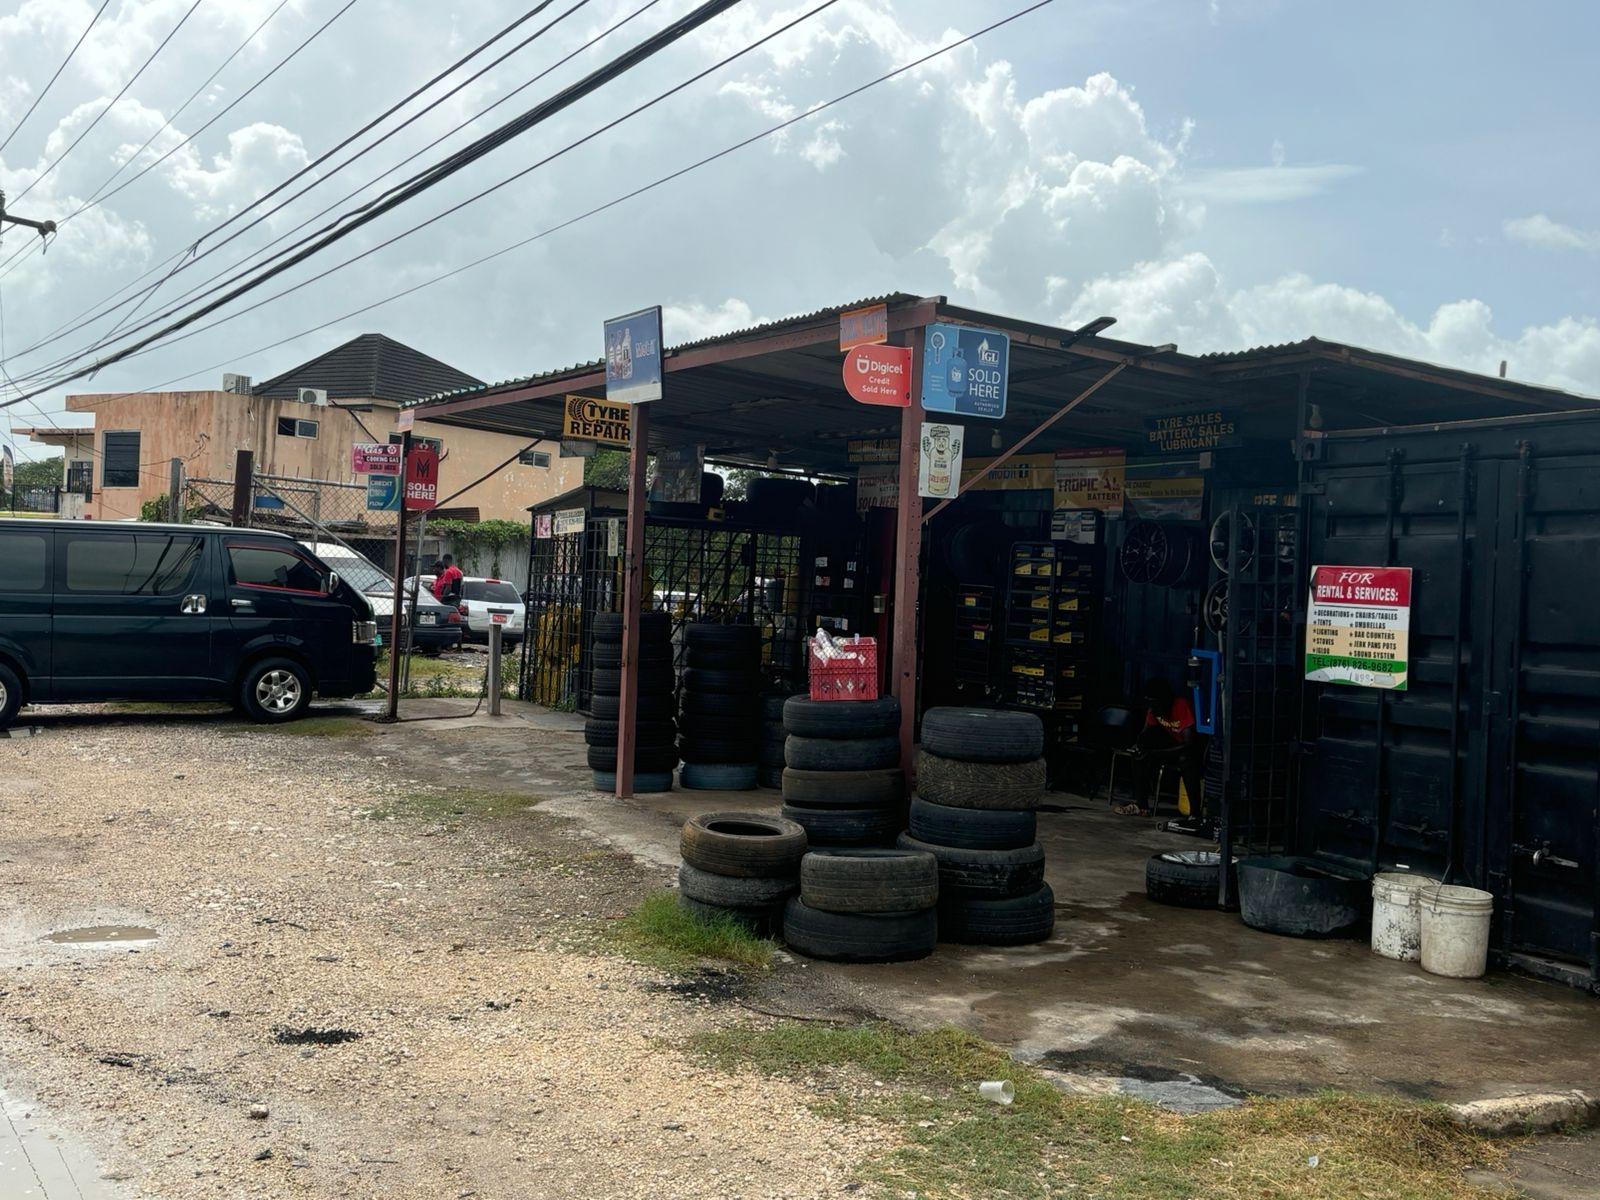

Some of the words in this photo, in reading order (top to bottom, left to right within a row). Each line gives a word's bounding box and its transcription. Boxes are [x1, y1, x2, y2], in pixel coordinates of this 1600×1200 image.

[981, 351, 998, 362] IGL
[871, 361, 903, 375] Digicel
[869, 376, 890, 385] Credit
[968, 368, 1001, 384] SOLD
[862, 385, 878, 394] Sold
[880, 386, 897, 395] Here
[969, 383, 1000, 399] HERE
[588, 404, 629, 421] TYRE
[1156, 415, 1183, 429] TYRE
[1186, 412, 1222, 426] SALES
[570, 421, 631, 441] REPAIR
[1149, 426, 1195, 442] BATTERY
[1199, 423, 1234, 437] SALES
[1160, 436, 1219, 451] LUBRICANT
[407, 481, 436, 491] SOLD
[407, 491, 436, 500] HERE
[1087, 492, 1121, 501] BATTERY
[1339, 572, 1375, 584] FOR
[1316, 585, 1345, 599] RENTAL
[1346, 587, 1353, 599] &
[1354, 587, 1399, 602] SERVICES:
[1318, 609, 1349, 618] DECORATIONS
[1355, 611, 1398, 620] CHAIRS/TABLES
[1355, 621, 1386, 630] UMBRELLAS
[1316, 629, 1338, 637] LIGHTING
[1354, 631, 1364, 639] BAR
[1366, 631, 1395, 640] COUNTERS
[1316, 638, 1334, 646] STOVES
[1354, 640, 1366, 648] JERK
[1367, 641, 1381, 649] PANS
[1382, 642, 1397, 650] POTS
[1354, 650, 1372, 658] SOUND
[1373, 651, 1395, 660] SYSTEM
[1352, 661, 1393, 674] 826-9682
